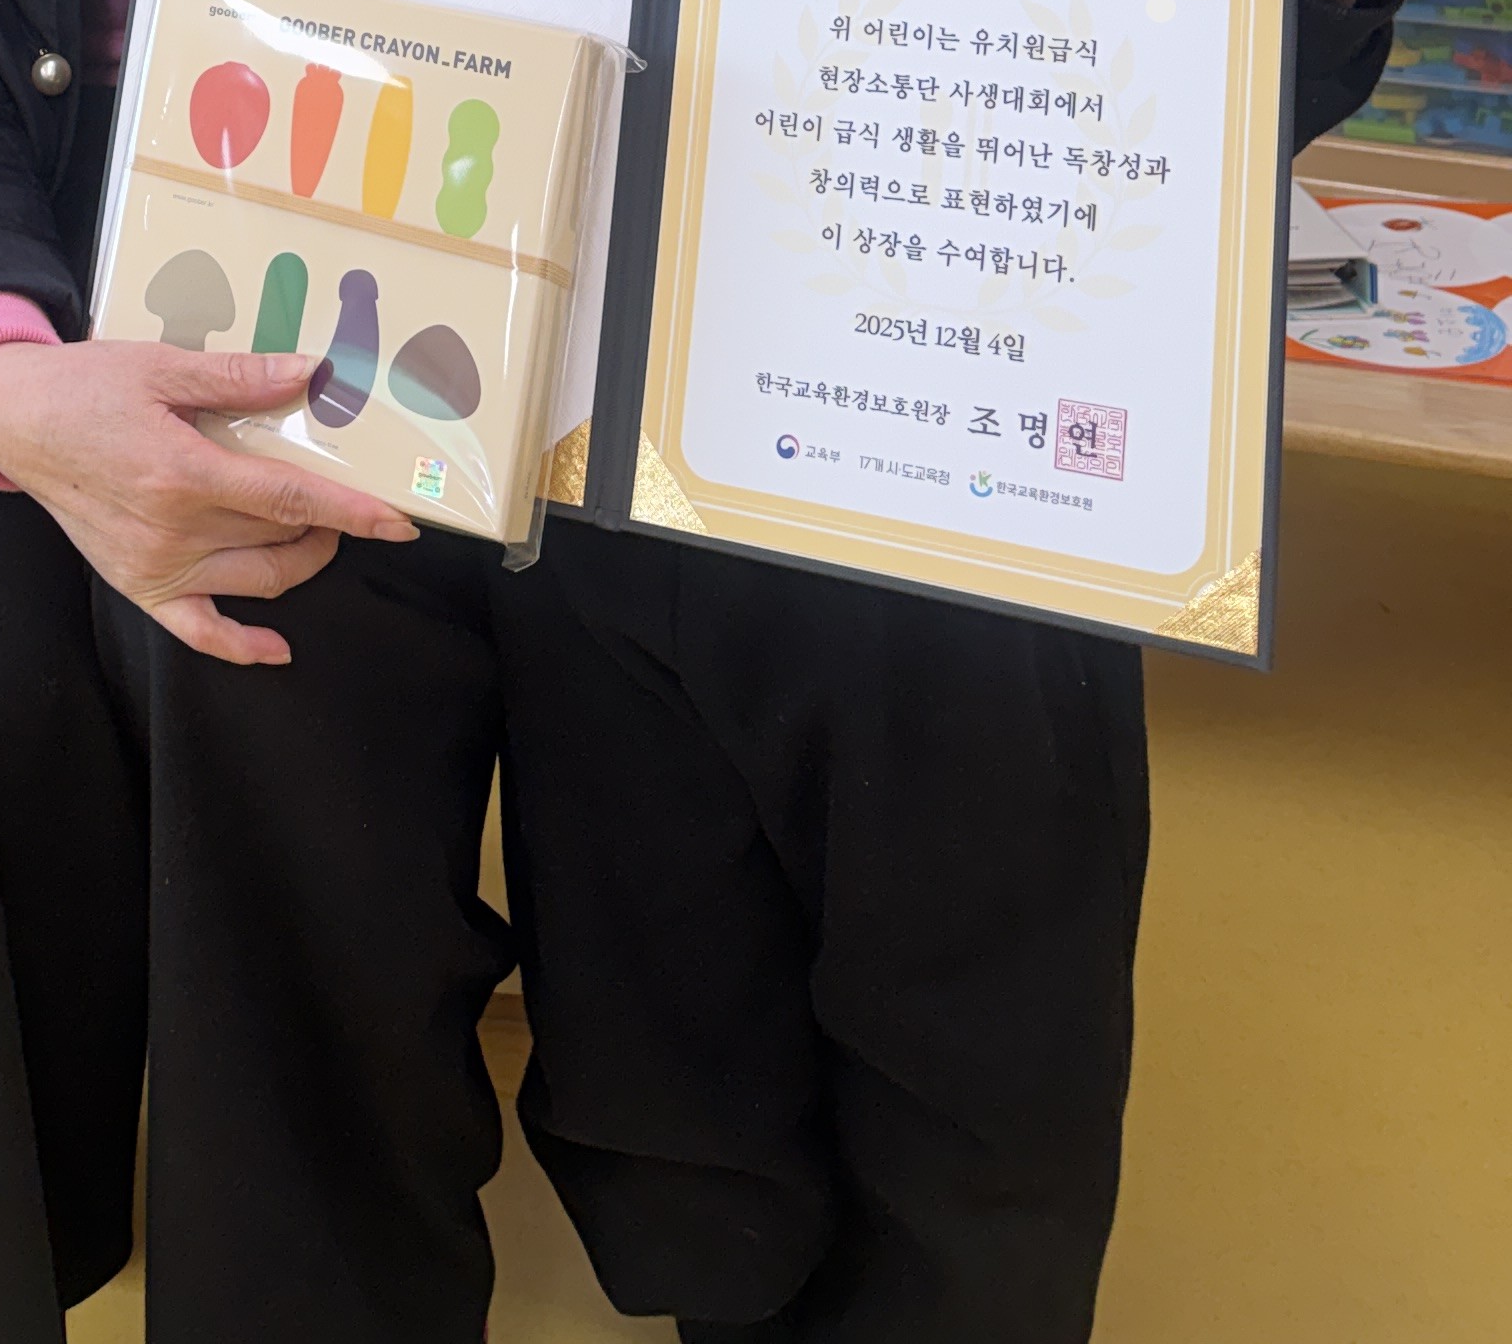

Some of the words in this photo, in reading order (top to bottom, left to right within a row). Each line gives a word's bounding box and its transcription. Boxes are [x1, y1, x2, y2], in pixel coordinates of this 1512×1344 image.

[208, 5, 250, 21] goob
[829, 15, 850, 41] 위
[863, 18, 960, 51] 어린이는
[969, 28, 1097, 67] 유치원급식
[819, 65, 939, 102] 현장소통단
[949, 79, 1102, 121] 사생대회에서
[755, 109, 822, 141] 어린이
[833, 119, 879, 149] 급식
[891, 126, 965, 158] 생활을
[975, 136, 1053, 168] 뛰어난
[1062, 146, 1170, 184] 독창성과
[809, 168, 930, 205] 창의력으로
[940, 187, 1096, 231] 표현하였기에
[821, 222, 841, 250] 이
[852, 227, 926, 261] 상장을
[936, 238, 1074, 283] 수여합니다.
[854, 312, 926, 346] 2025년
[934, 326, 980, 355] 12월
[987, 333, 1024, 362] 4일
[755, 372, 950, 425] 한국교육환경보호원장
[804, 445, 840, 463] 교육부
[859, 455, 883, 472] 17개
[996, 480, 1092, 511] 한국교육환경보호원
